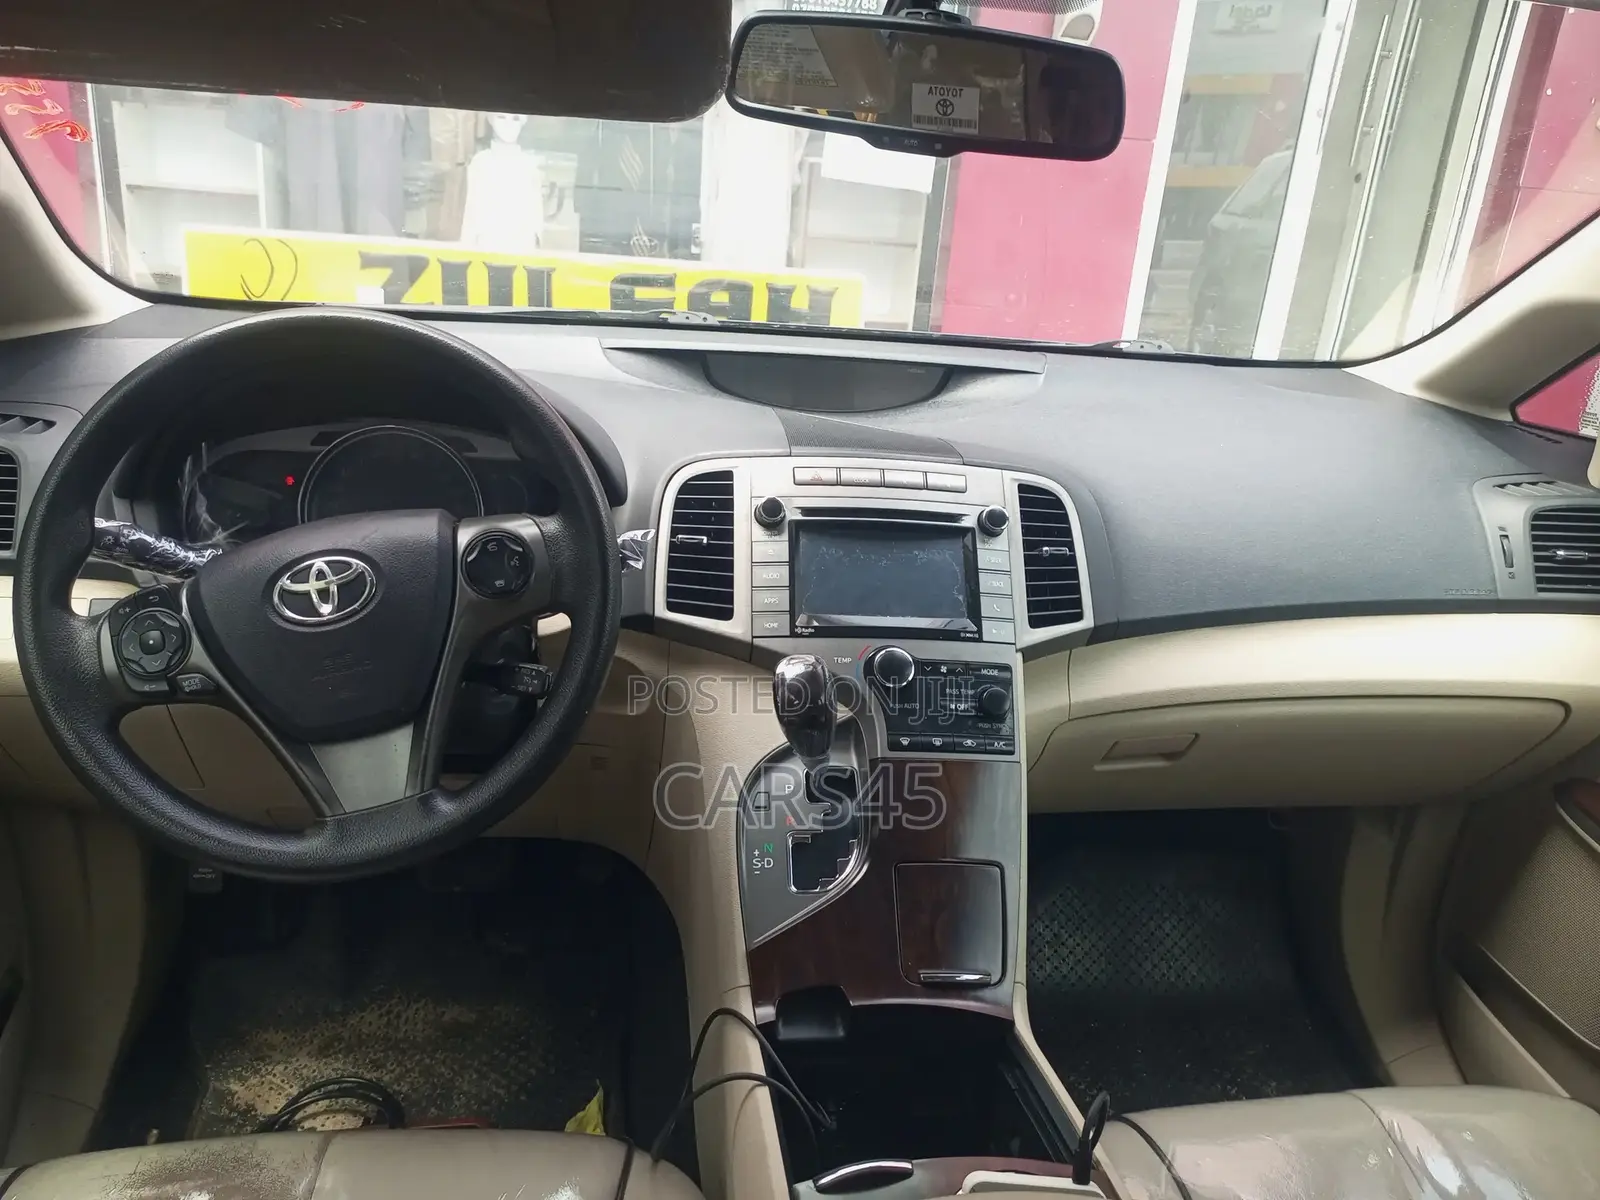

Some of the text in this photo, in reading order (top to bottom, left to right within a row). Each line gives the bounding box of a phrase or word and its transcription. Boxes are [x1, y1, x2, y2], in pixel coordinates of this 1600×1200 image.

[763, 621, 779, 629] HOME
[833, 656, 853, 664] TEMP
[981, 668, 999, 676] MODE
[182, 677, 200, 686] MODE
[993, 741, 1006, 749] A/C
[785, 784, 794, 794] P
[763, 843, 773, 853] N
